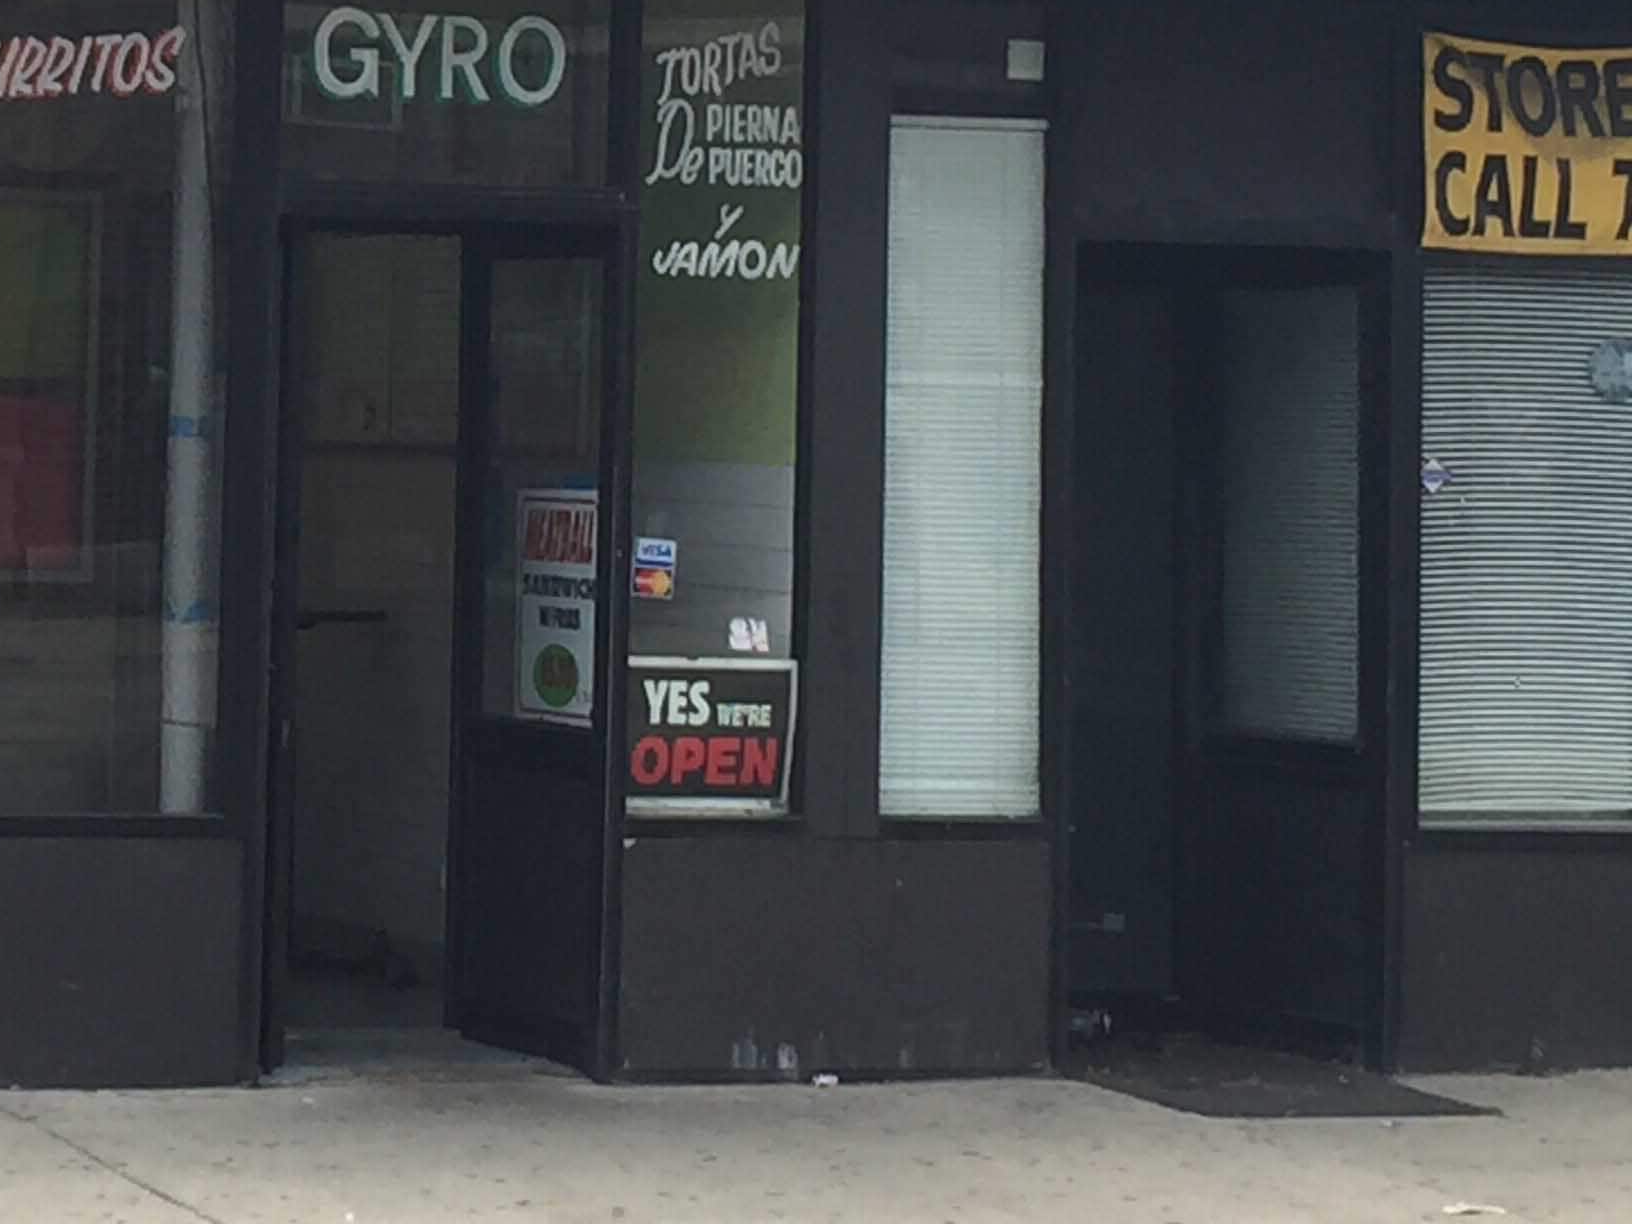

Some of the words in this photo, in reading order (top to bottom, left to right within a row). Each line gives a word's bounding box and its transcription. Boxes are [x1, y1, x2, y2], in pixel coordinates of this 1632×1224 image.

[314, 6, 566, 105] GYRO
[656, 22, 781, 106] TORTAS
[1433, 45, 1632, 138] STORE
[707, 104, 801, 144] PIERNA
[708, 148, 803, 188] PUERCO
[1434, 151, 1588, 240] CALL
[653, 240, 800, 279] JAMON
[643, 680, 711, 726] YES
[630, 737, 778, 786] OPEN
